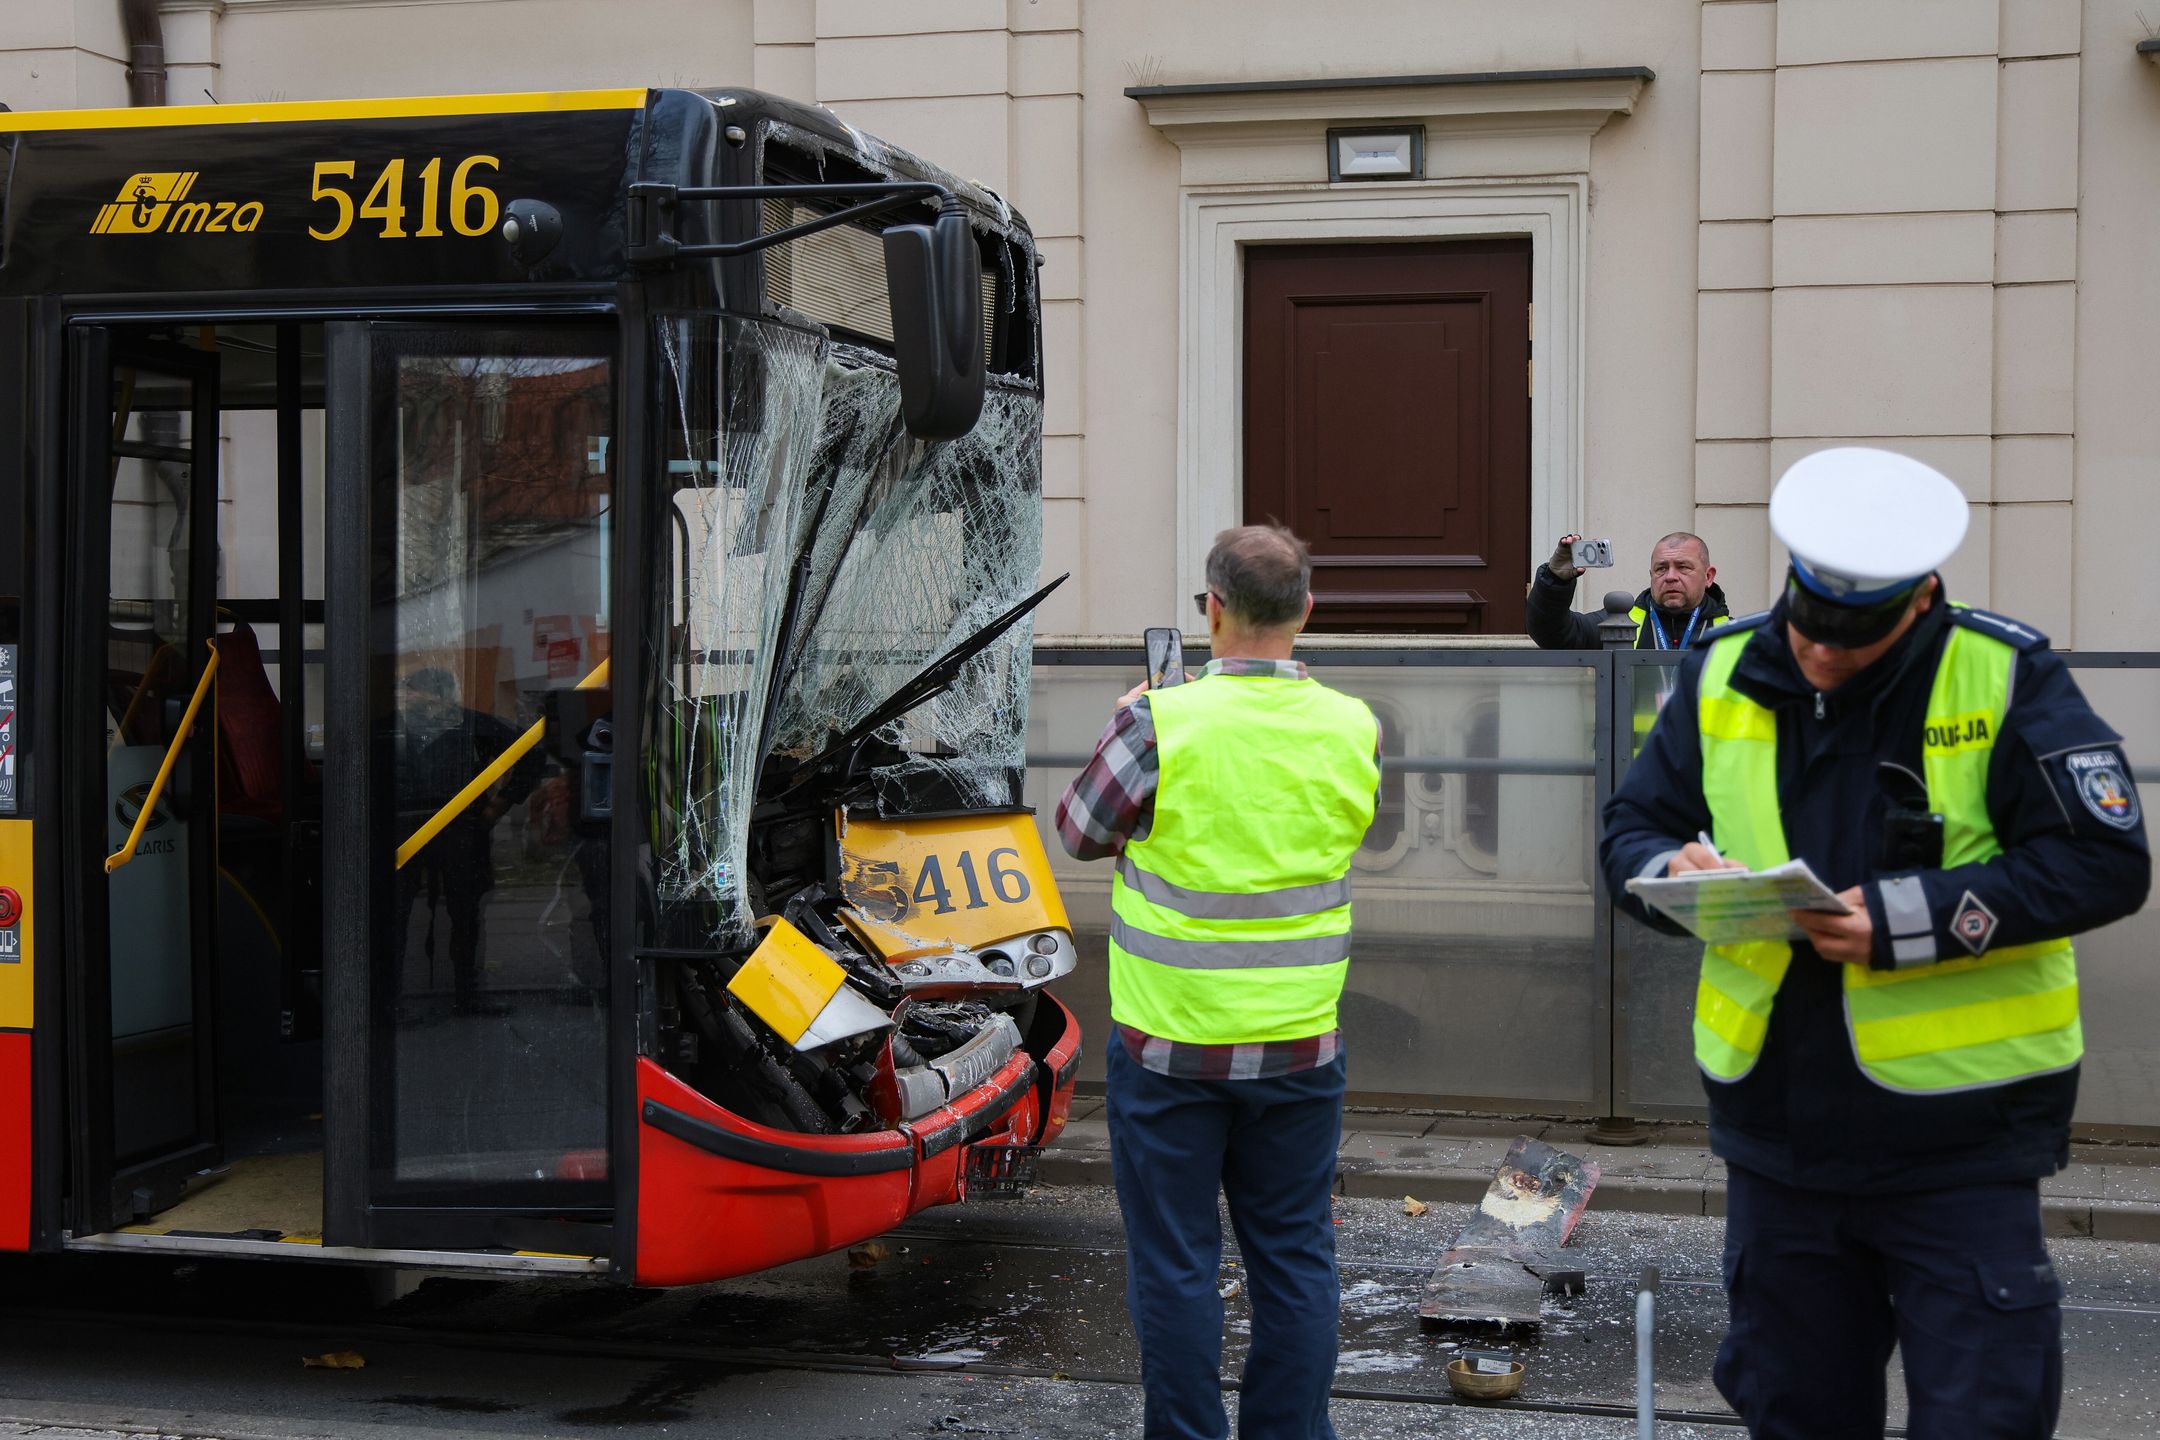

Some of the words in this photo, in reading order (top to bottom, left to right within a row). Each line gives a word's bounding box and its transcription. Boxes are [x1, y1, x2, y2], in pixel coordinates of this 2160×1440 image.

[308, 154, 500, 241] 5416
[166, 201, 264, 233] mza
[1925, 718, 1989, 747] OLICJA
[2072, 754, 2117, 769] POLICJA
